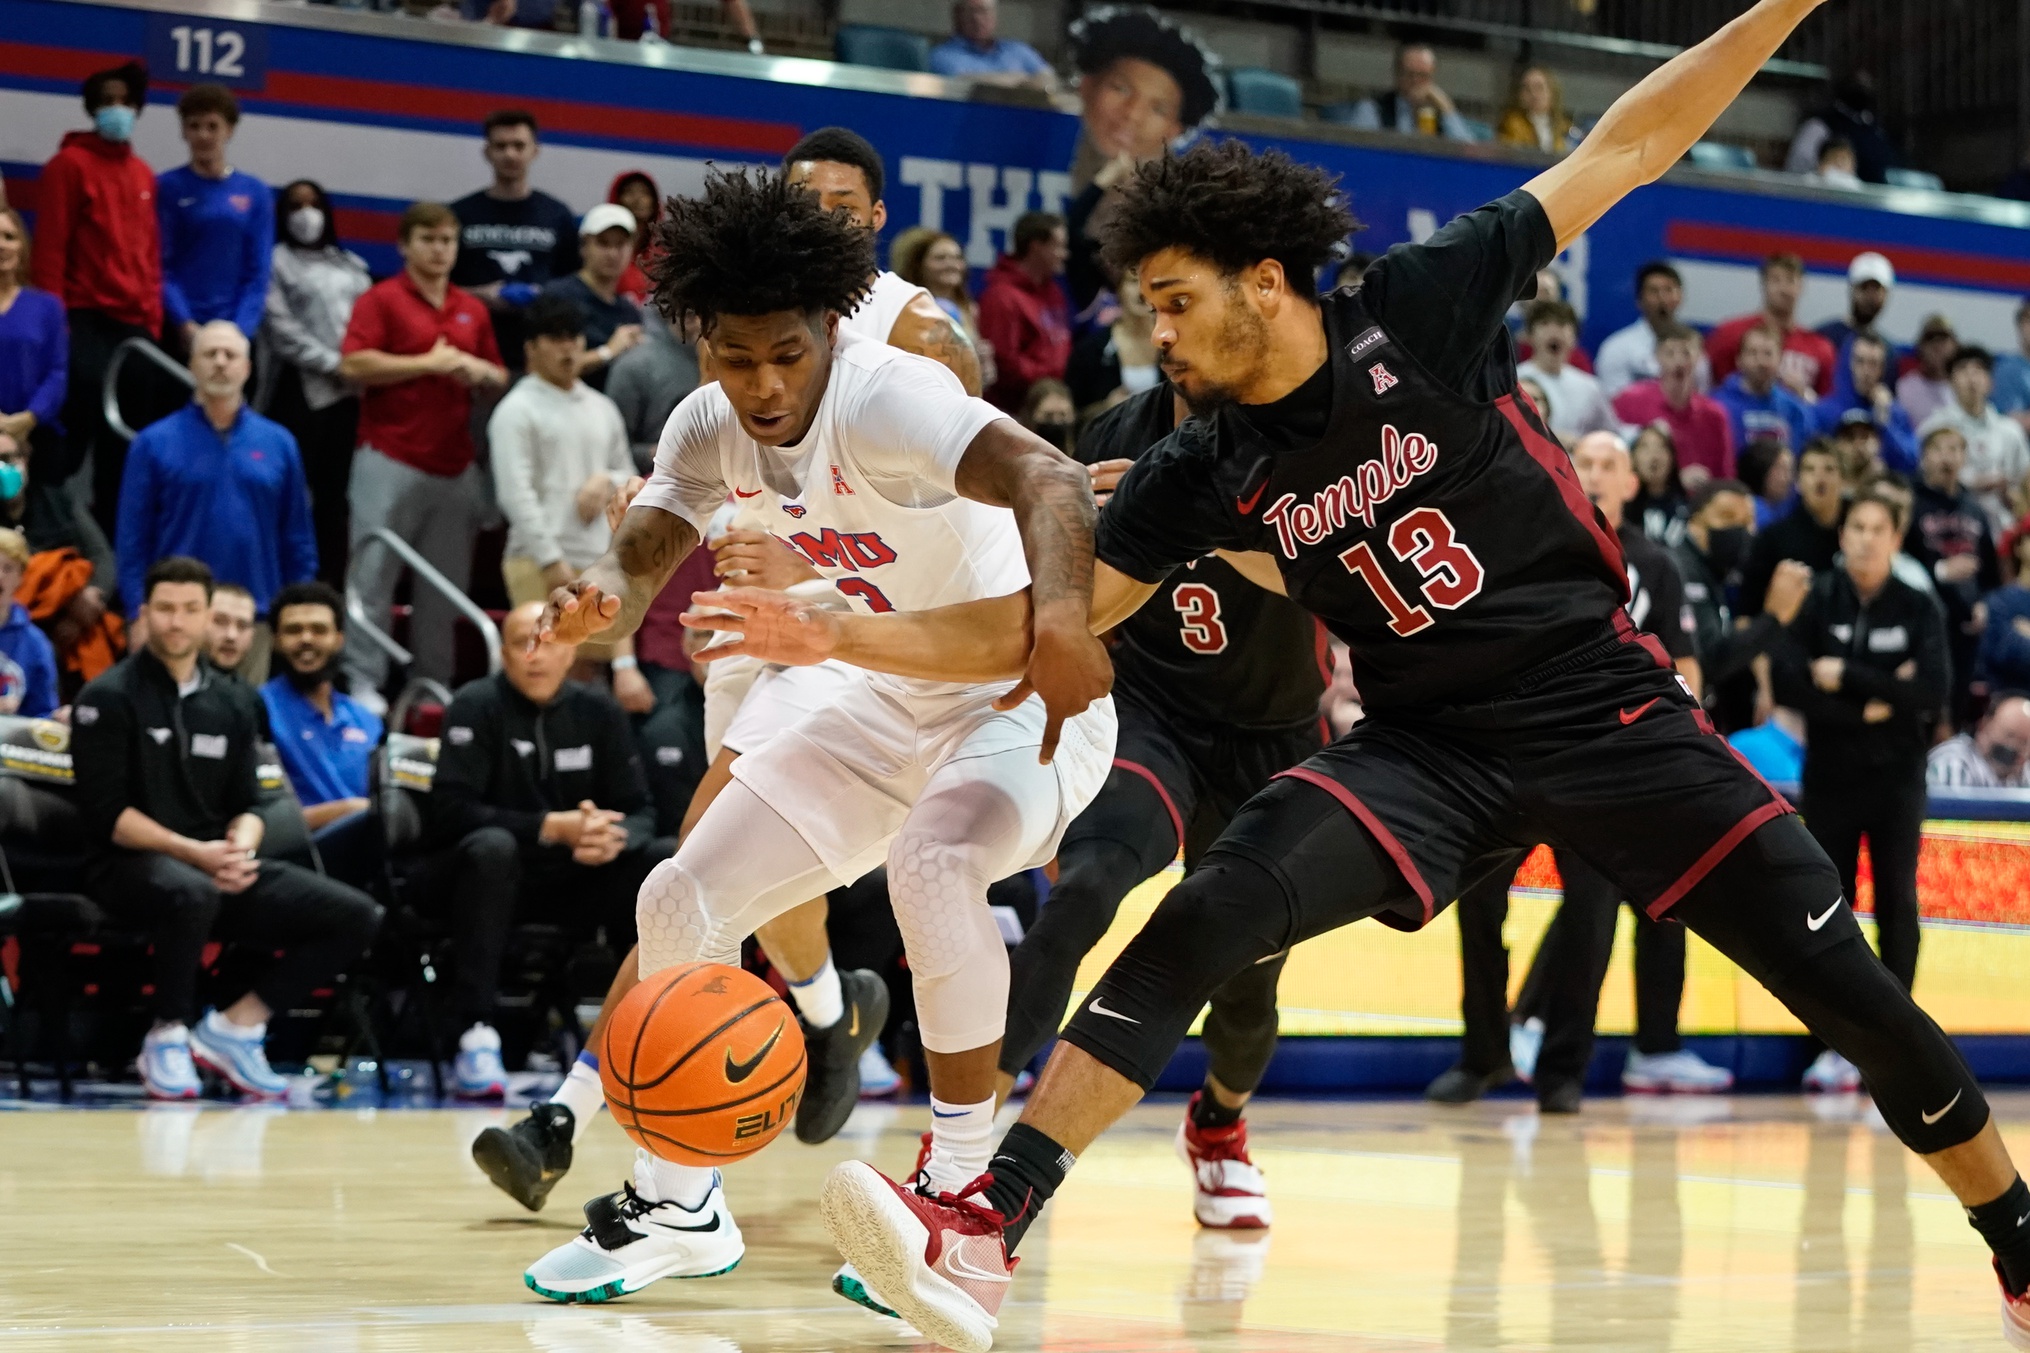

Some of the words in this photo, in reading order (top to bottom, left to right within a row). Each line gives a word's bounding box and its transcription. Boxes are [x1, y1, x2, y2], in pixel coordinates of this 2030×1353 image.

[170, 25, 245, 78] 112
[1350, 331, 1383, 355] COACH
[1262, 423, 1438, 560] Temple
[1337, 506, 1485, 638] 13
[1172, 582, 1228, 655] 3
